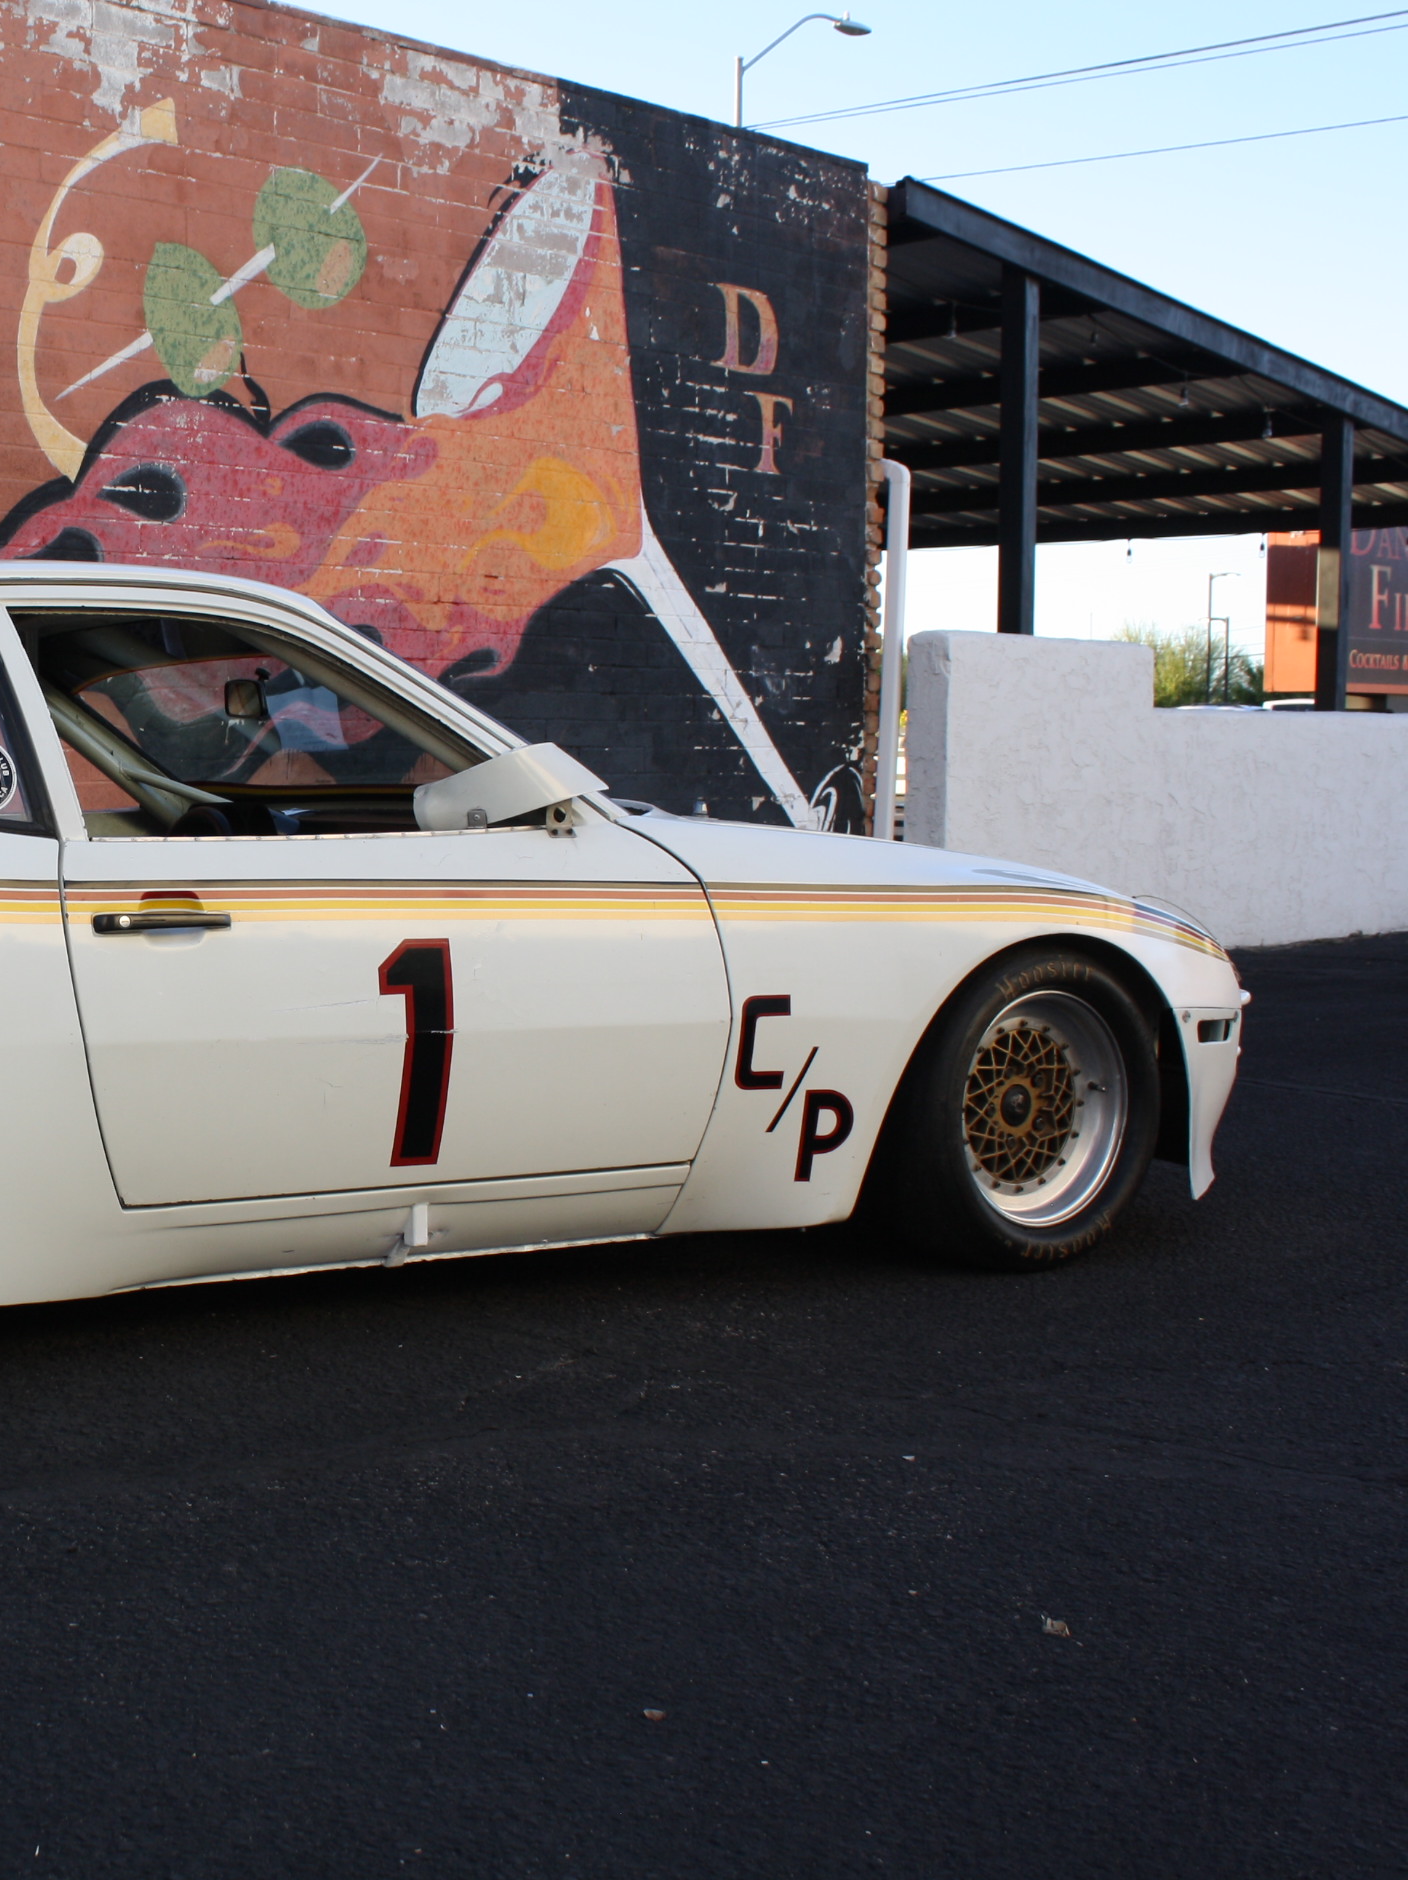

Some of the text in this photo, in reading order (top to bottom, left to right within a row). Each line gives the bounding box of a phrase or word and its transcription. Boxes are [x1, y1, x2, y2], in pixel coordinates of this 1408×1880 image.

[710, 282, 780, 376] D
[743, 391, 793, 475] F
[1368, 564, 1408, 631] FI
[378, 937, 454, 1167] 1
